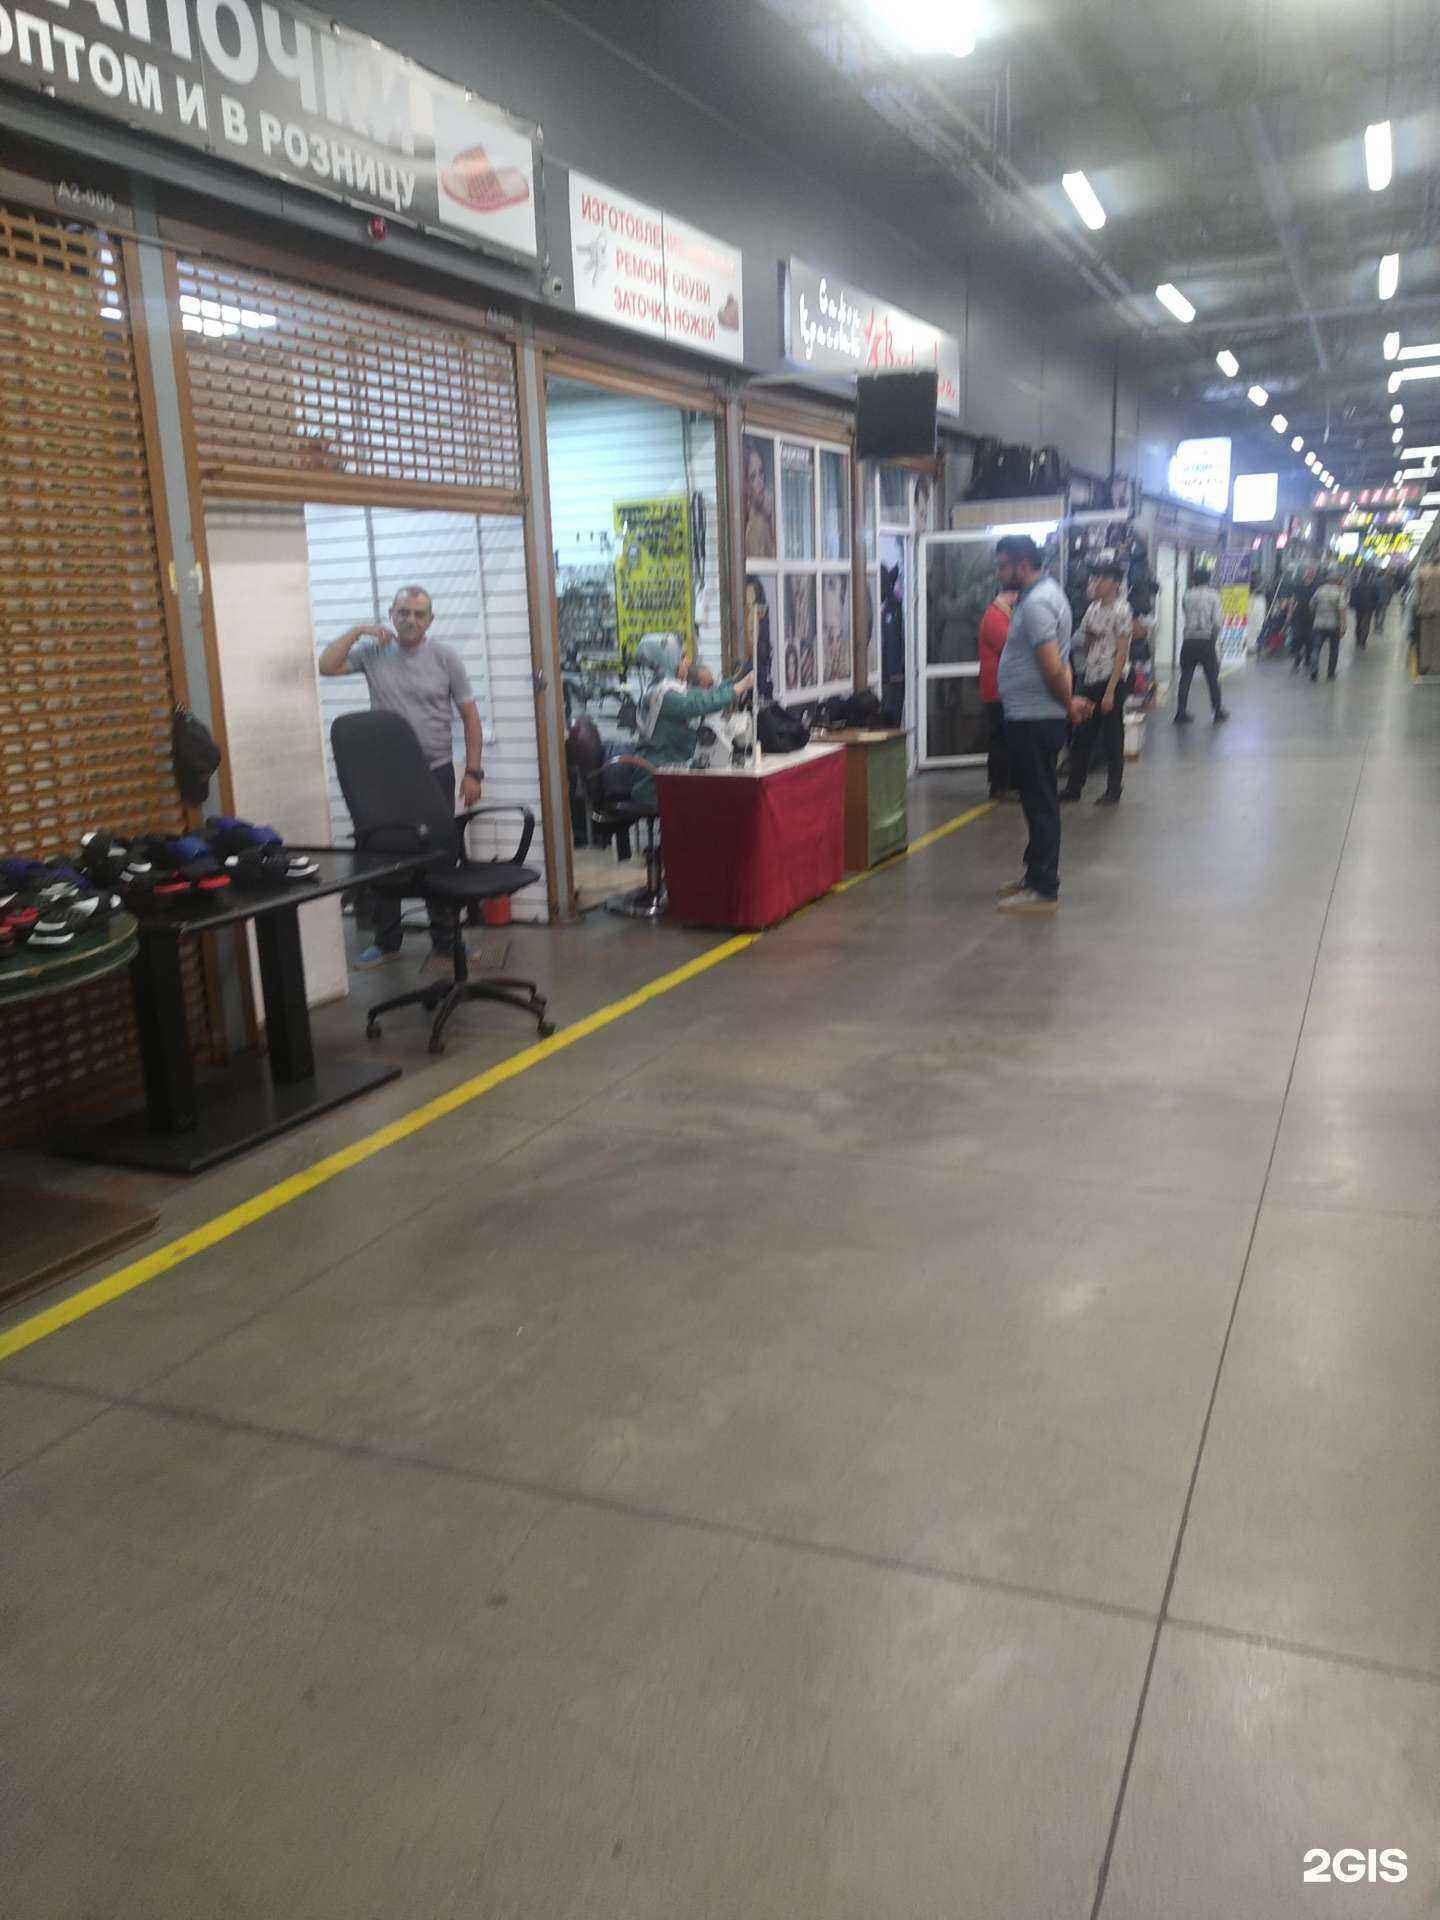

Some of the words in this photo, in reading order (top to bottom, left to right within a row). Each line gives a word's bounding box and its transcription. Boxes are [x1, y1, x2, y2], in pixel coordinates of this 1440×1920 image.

[176, 74, 207, 131] И
[221, 94, 248, 146] В
[259, 109, 415, 212] РОЗНИЦУ
[614, 286, 671, 327] ЗАТОЧКА
